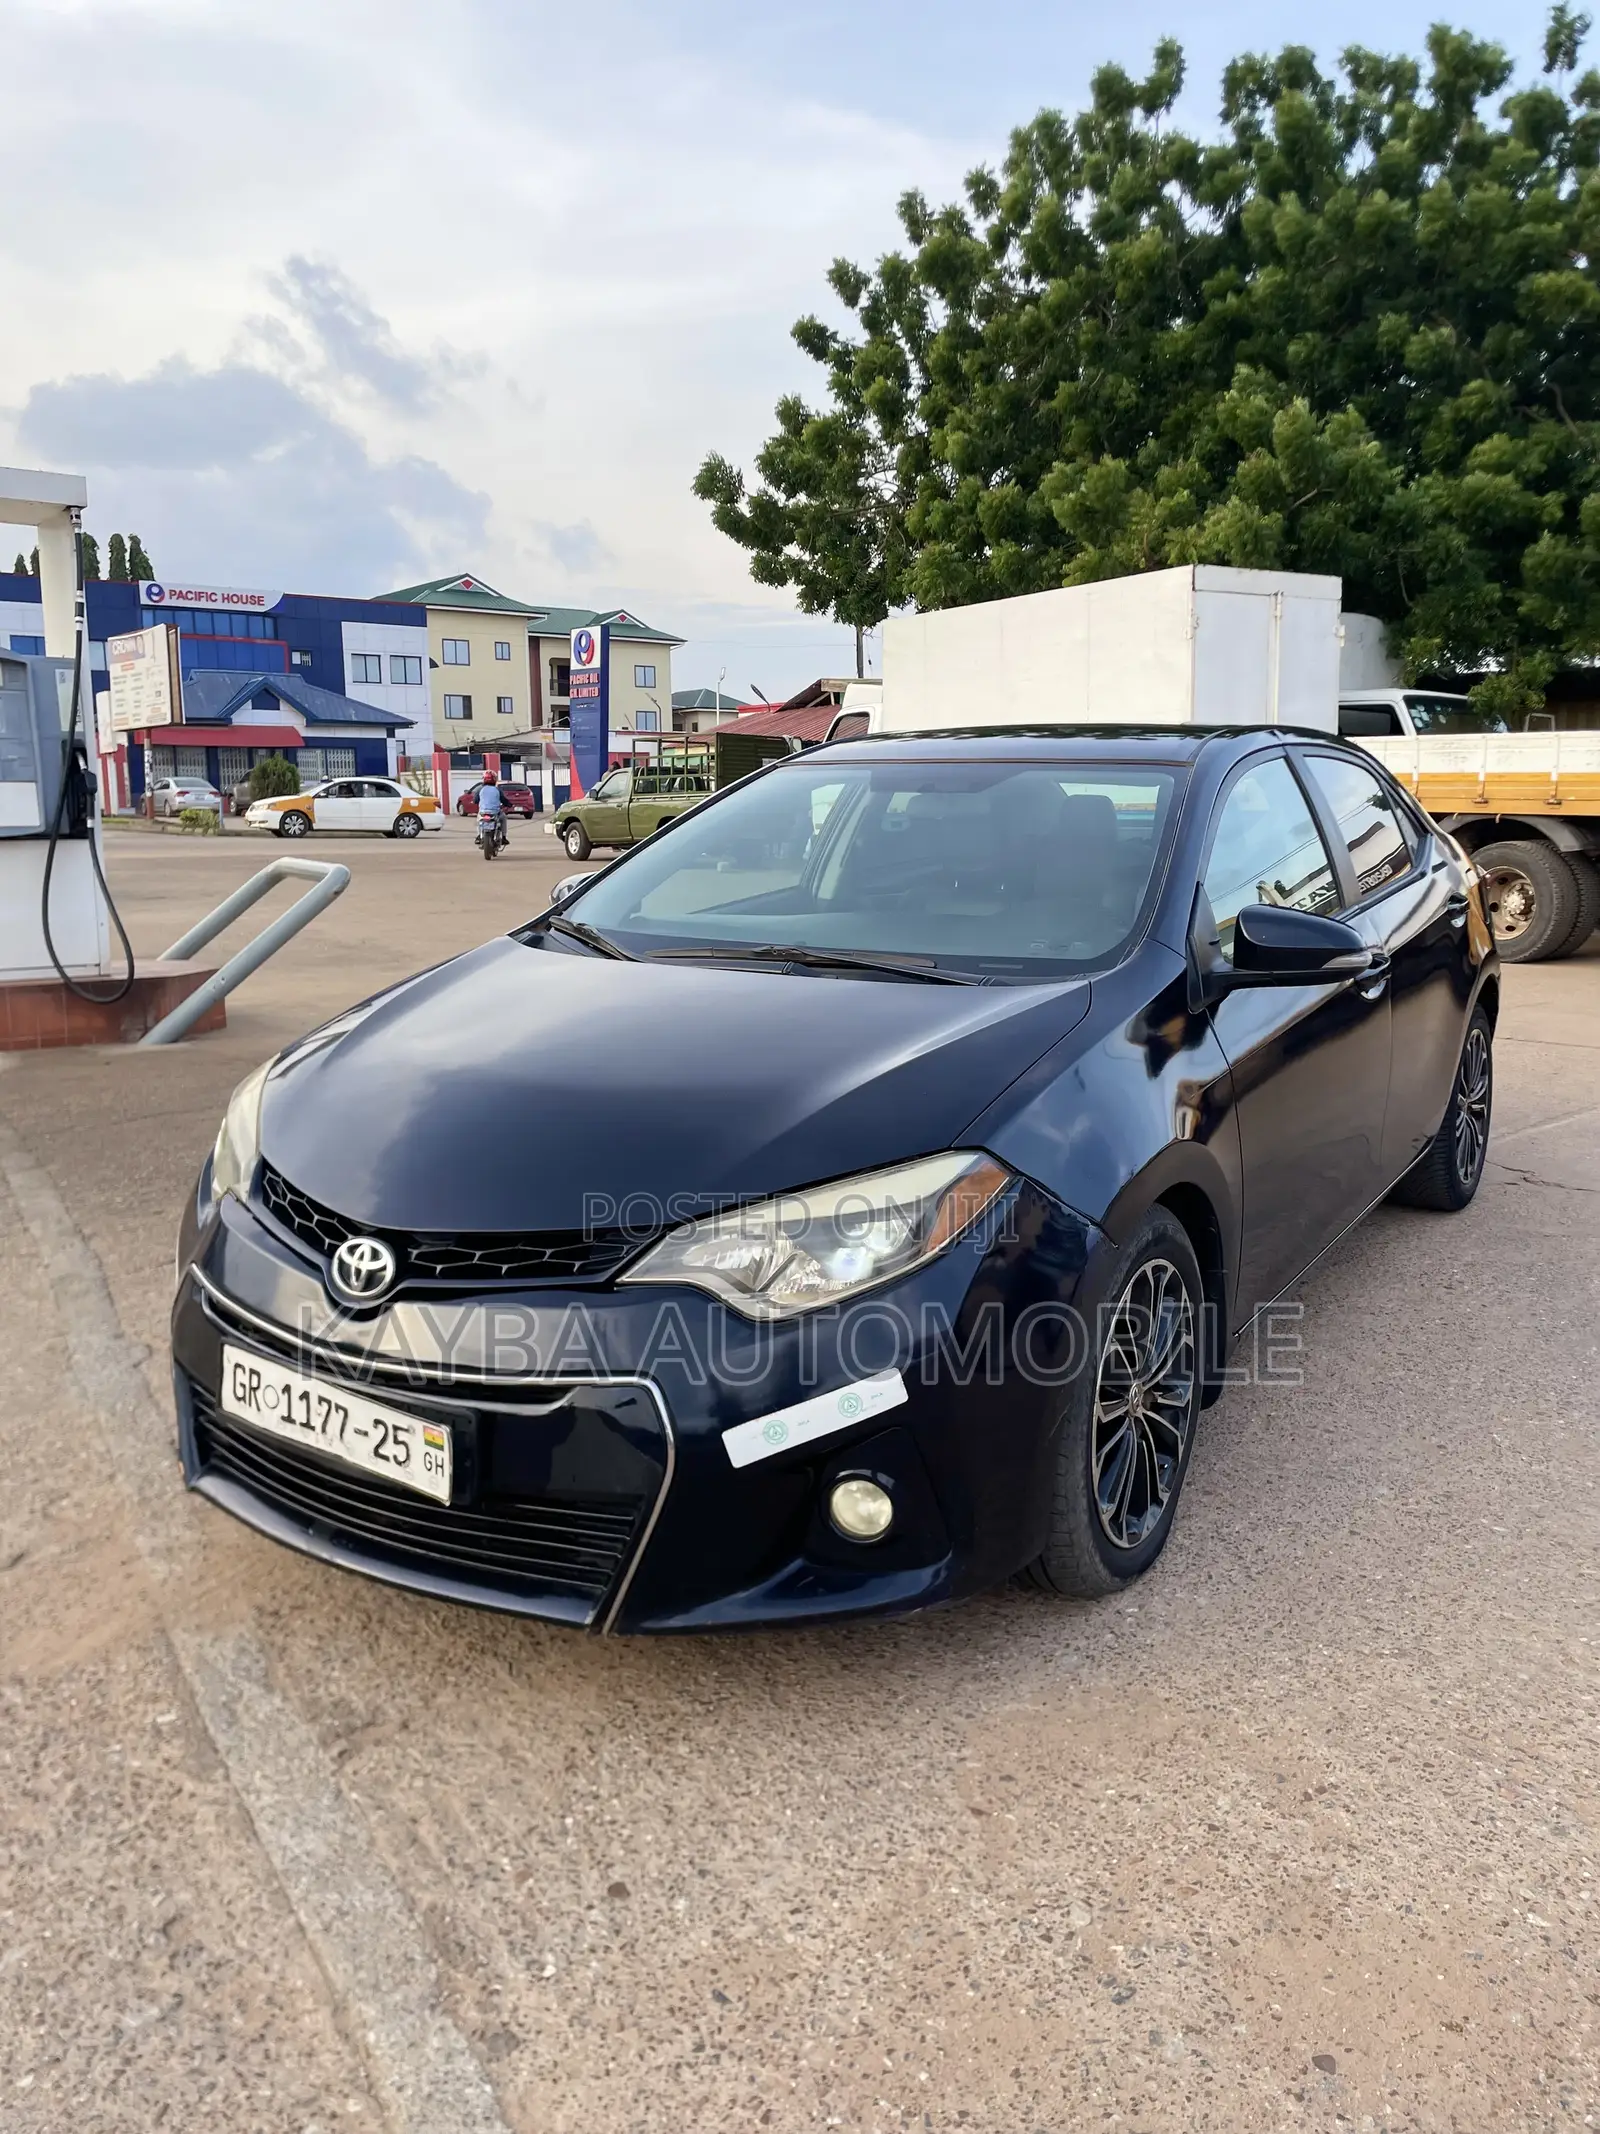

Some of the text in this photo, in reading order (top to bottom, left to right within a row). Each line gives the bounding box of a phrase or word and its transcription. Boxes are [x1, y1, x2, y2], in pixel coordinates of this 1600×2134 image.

[168, 589, 265, 606] PACIFIC HOUSE
[570, 672, 599, 686] PACIFIC OIL
[579, 687, 599, 698] LIMITED
[232, 1362, 413, 1467] GR 1177-25
[423, 1451, 445, 1478] GH
